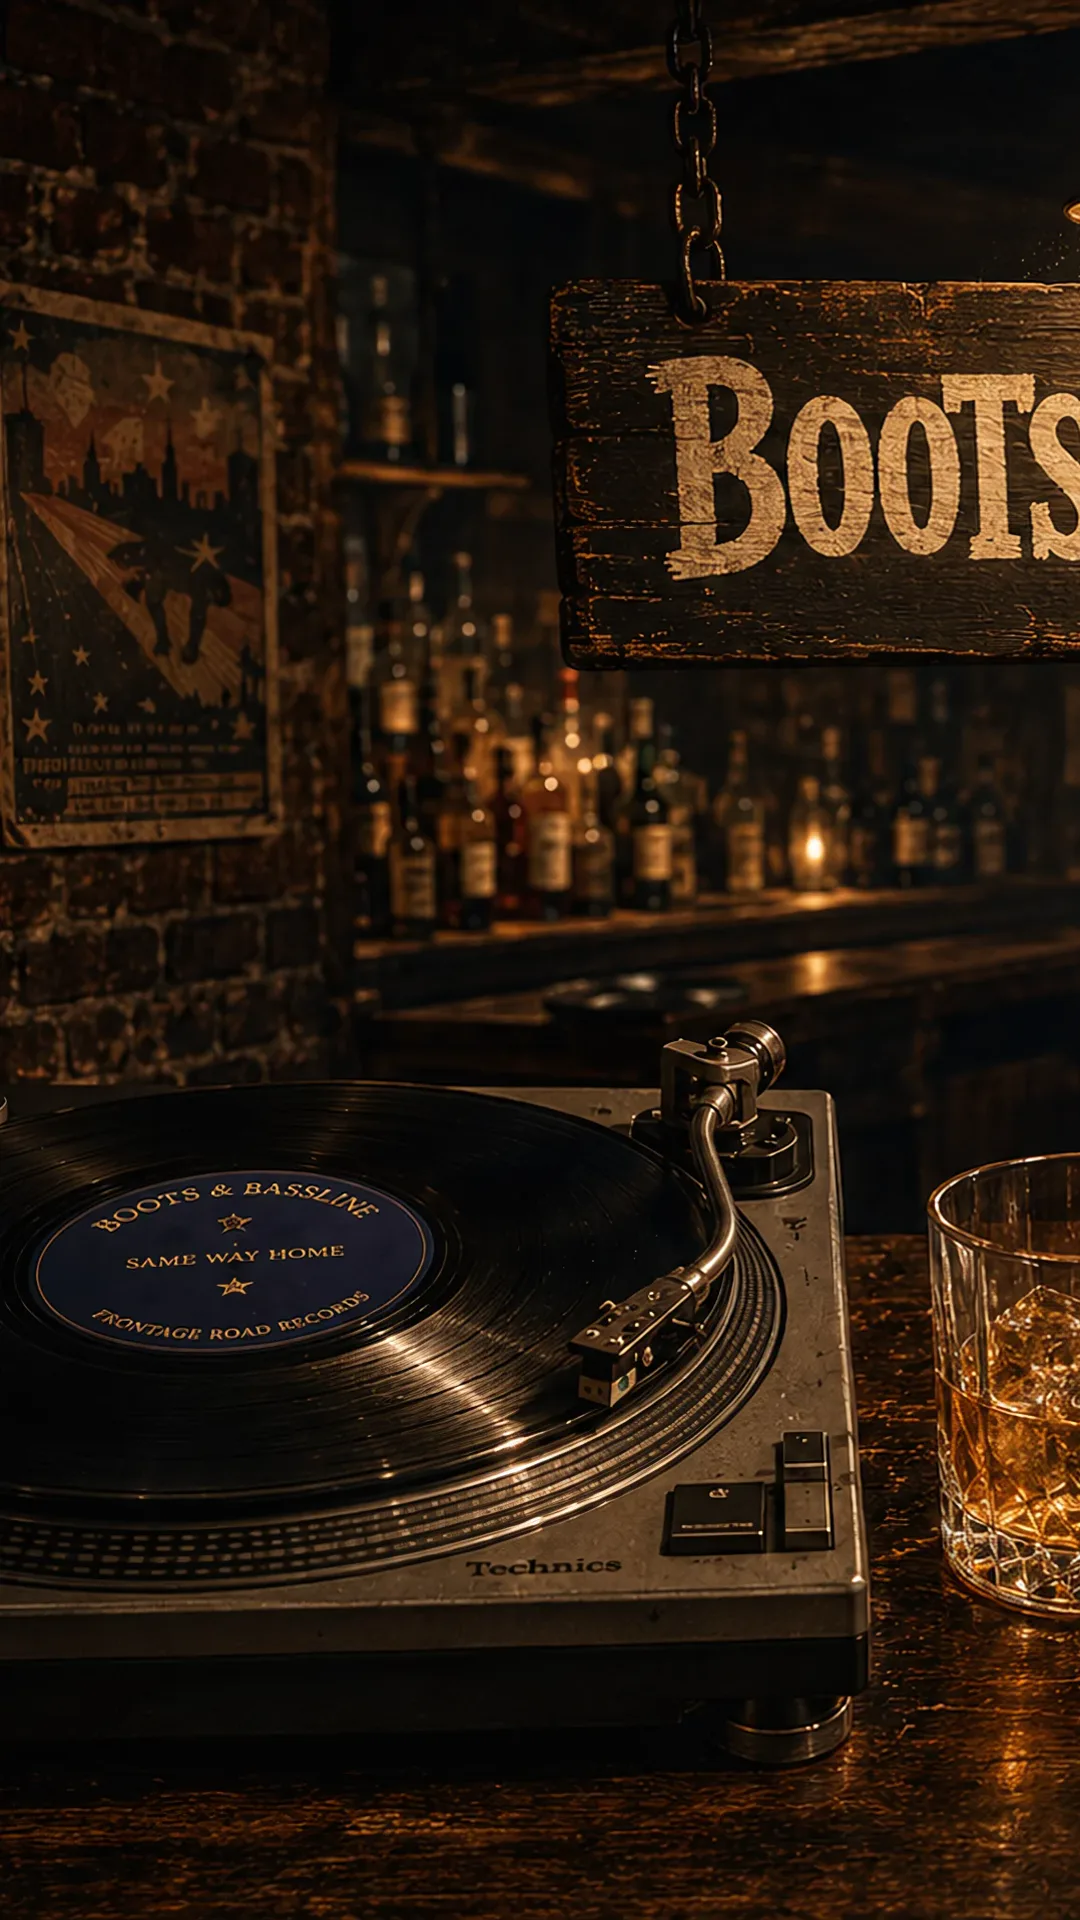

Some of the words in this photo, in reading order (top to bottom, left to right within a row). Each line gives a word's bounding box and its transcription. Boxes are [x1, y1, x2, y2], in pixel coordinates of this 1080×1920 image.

[91, 1187, 201, 1234] BOOTS
[211, 1183, 234, 1198] &
[244, 1182, 380, 1221] BASSLINE
[126, 1254, 197, 1270] SAME
[206, 1249, 260, 1264] WAY
[269, 1245, 345, 1261] HOME
[92, 1308, 203, 1341] FRONTAGE
[209, 1324, 272, 1341] ROAD
[278, 1290, 371, 1332] RECORDS
[465, 1557, 623, 1577] Technics
